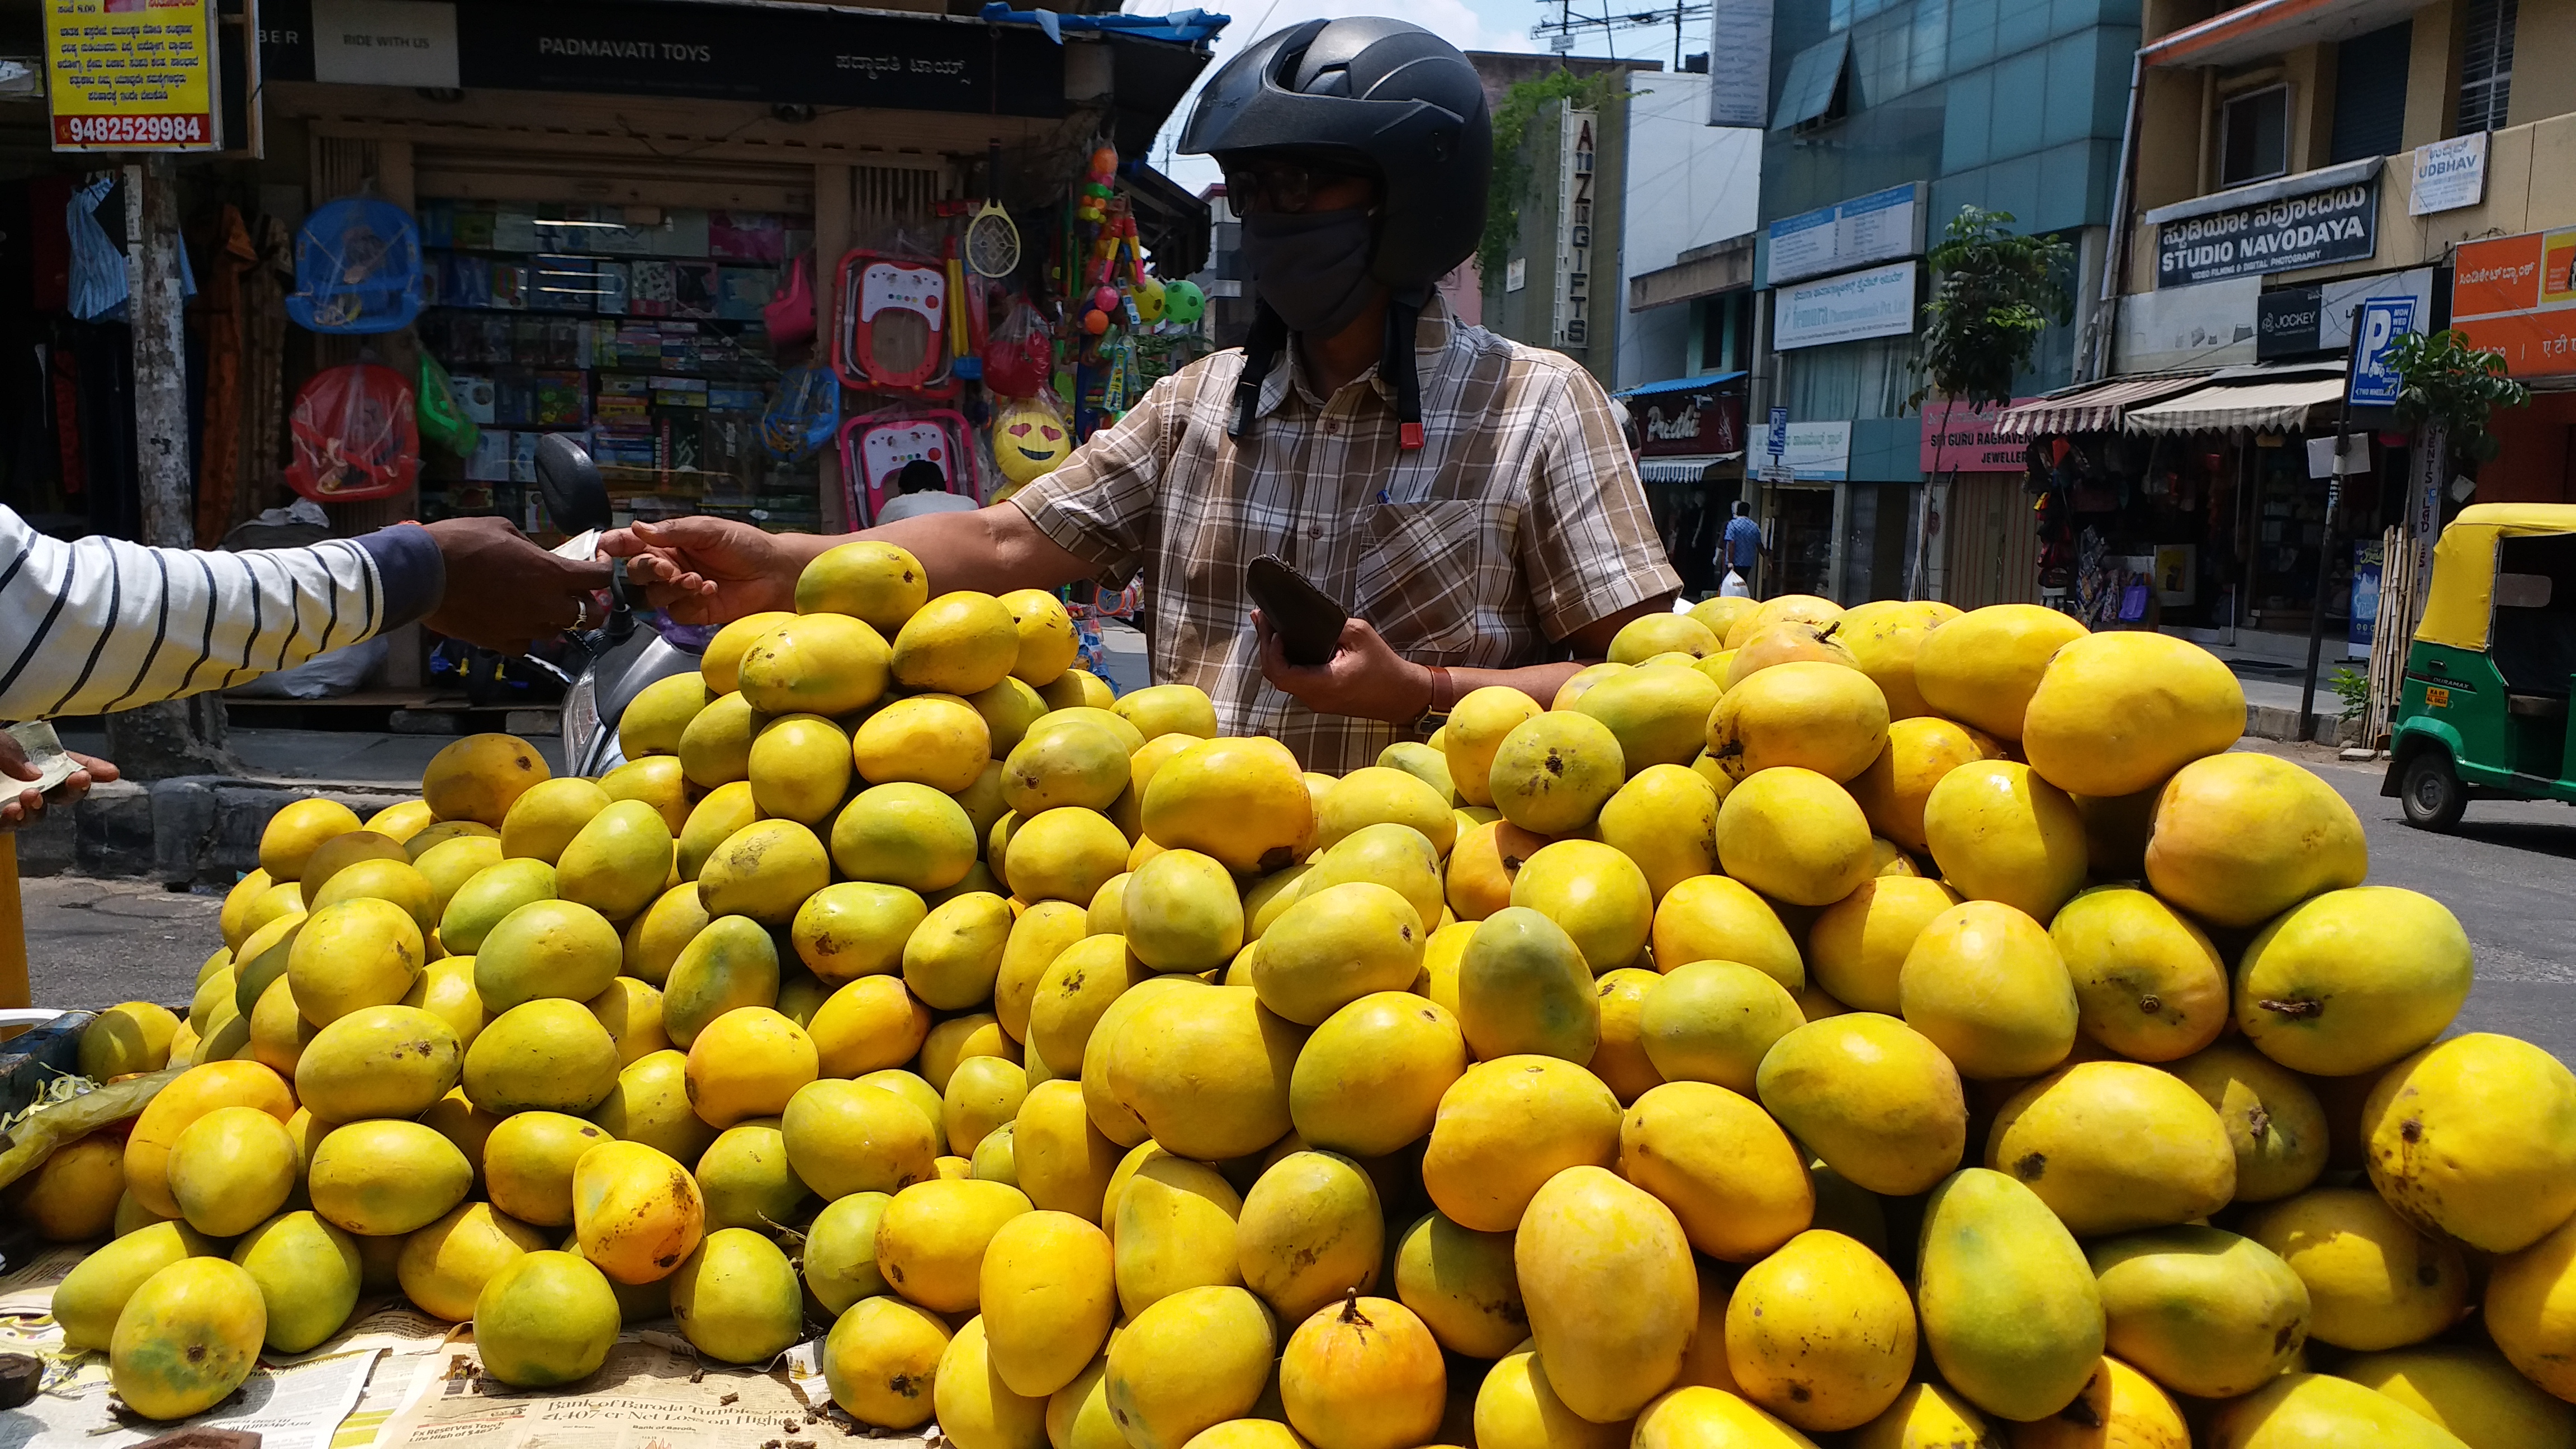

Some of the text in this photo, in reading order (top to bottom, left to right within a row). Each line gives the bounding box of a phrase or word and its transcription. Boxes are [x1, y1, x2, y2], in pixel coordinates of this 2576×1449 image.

[343, 34, 430, 49] RIDE WITH US
[538, 37, 711, 62] PADMAVATI TOYS
[70, 116, 201, 141] 9482529984
[2419, 154, 2478, 178] UDBHAV
[2162, 215, 2365, 272] STUDIO NAVODAYA
[2270, 249, 2322, 267] PHOTOGRAPHY
[2275, 311, 2316, 329] JOCKEY
[2393, 318, 2407, 326] WED
[2392, 326, 2404, 335] FRI
[2359, 309, 2391, 374] P
[1930, 433, 1945, 447] SI
[1948, 433, 1974, 446] GURU
[2433, 677, 2470, 689] DURAMAX
[546, 1399, 598, 1411] Bank
[598, 1399, 620, 1408] of
[621, 1400, 683, 1412] Baroda
[689, 1405, 763, 1416] Tumbles
[628, 1410, 659, 1420] Net
[664, 1413, 704, 1422] Loss
[427, 1424, 473, 1436] Reserves
